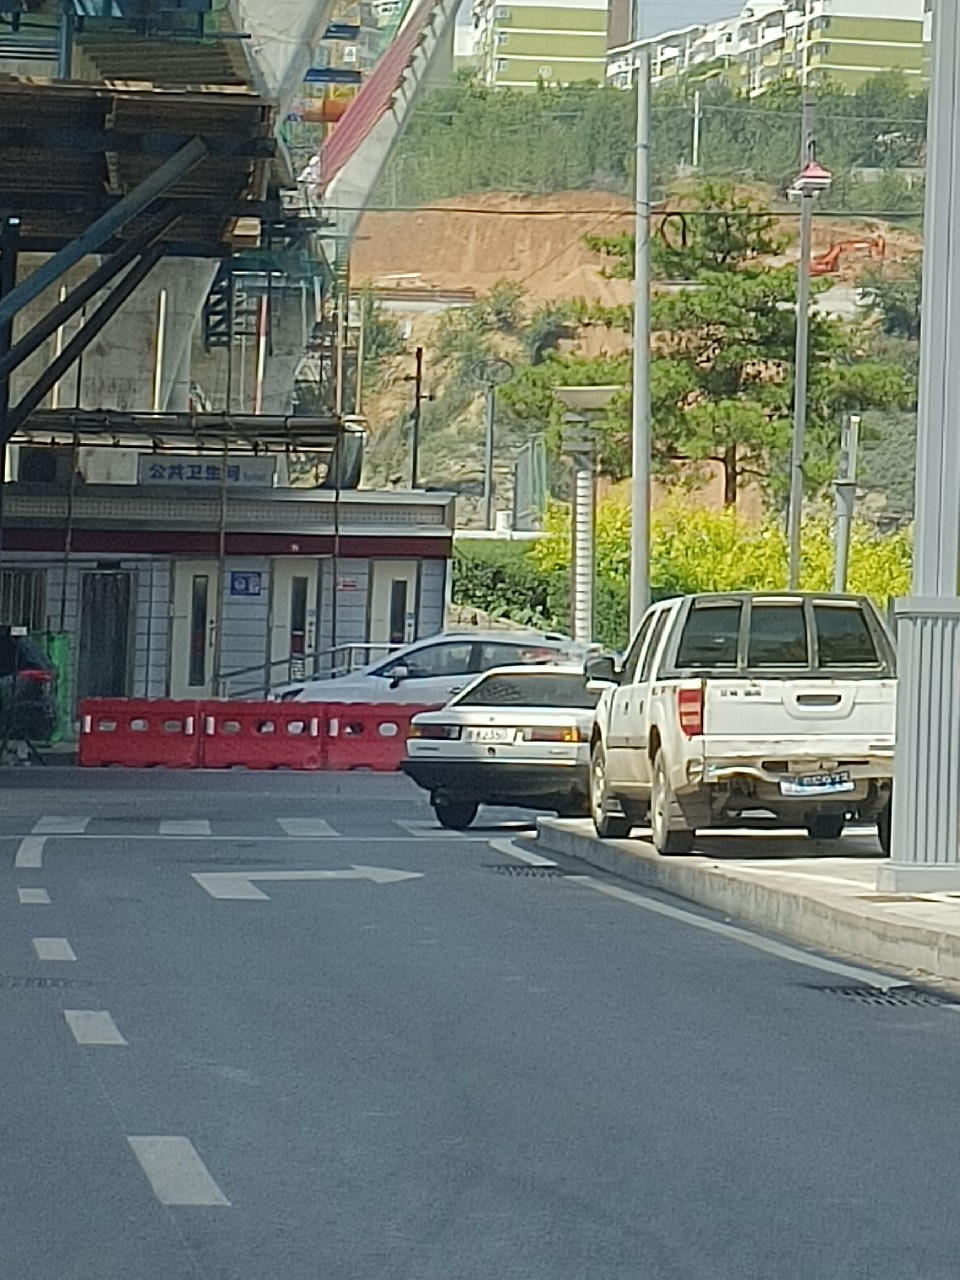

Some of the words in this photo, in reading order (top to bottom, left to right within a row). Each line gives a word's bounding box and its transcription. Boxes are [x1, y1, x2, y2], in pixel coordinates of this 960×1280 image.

[149, 463, 240, 482] 公共卫生间
